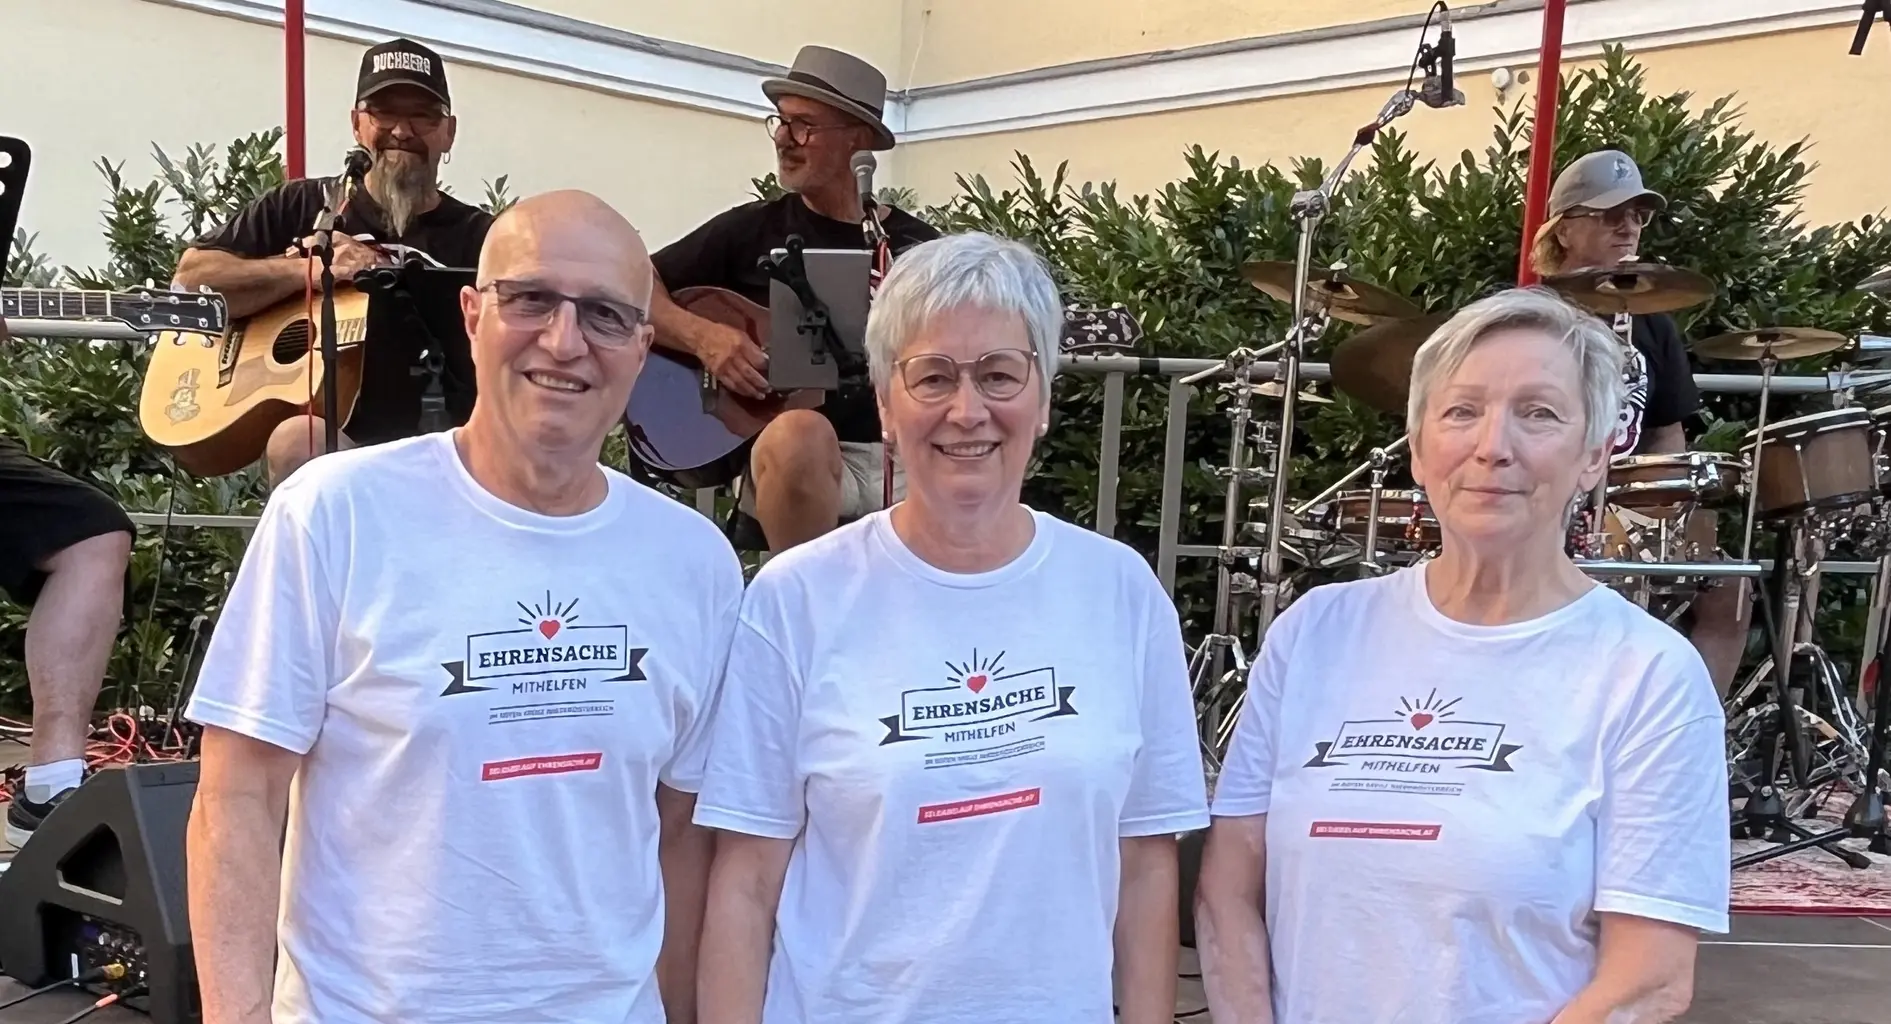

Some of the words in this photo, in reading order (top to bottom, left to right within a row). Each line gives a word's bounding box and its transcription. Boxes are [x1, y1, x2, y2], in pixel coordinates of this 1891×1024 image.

[478, 644, 618, 669] EHRENSACHE
[512, 677, 587, 694] MITHELFEN
[912, 685, 1046, 721] EHRENSACHE
[944, 721, 1016, 743] MITHELFEN
[1340, 734, 1487, 751] EHRENSACHE
[1360, 760, 1441, 774] MITHELFEN
